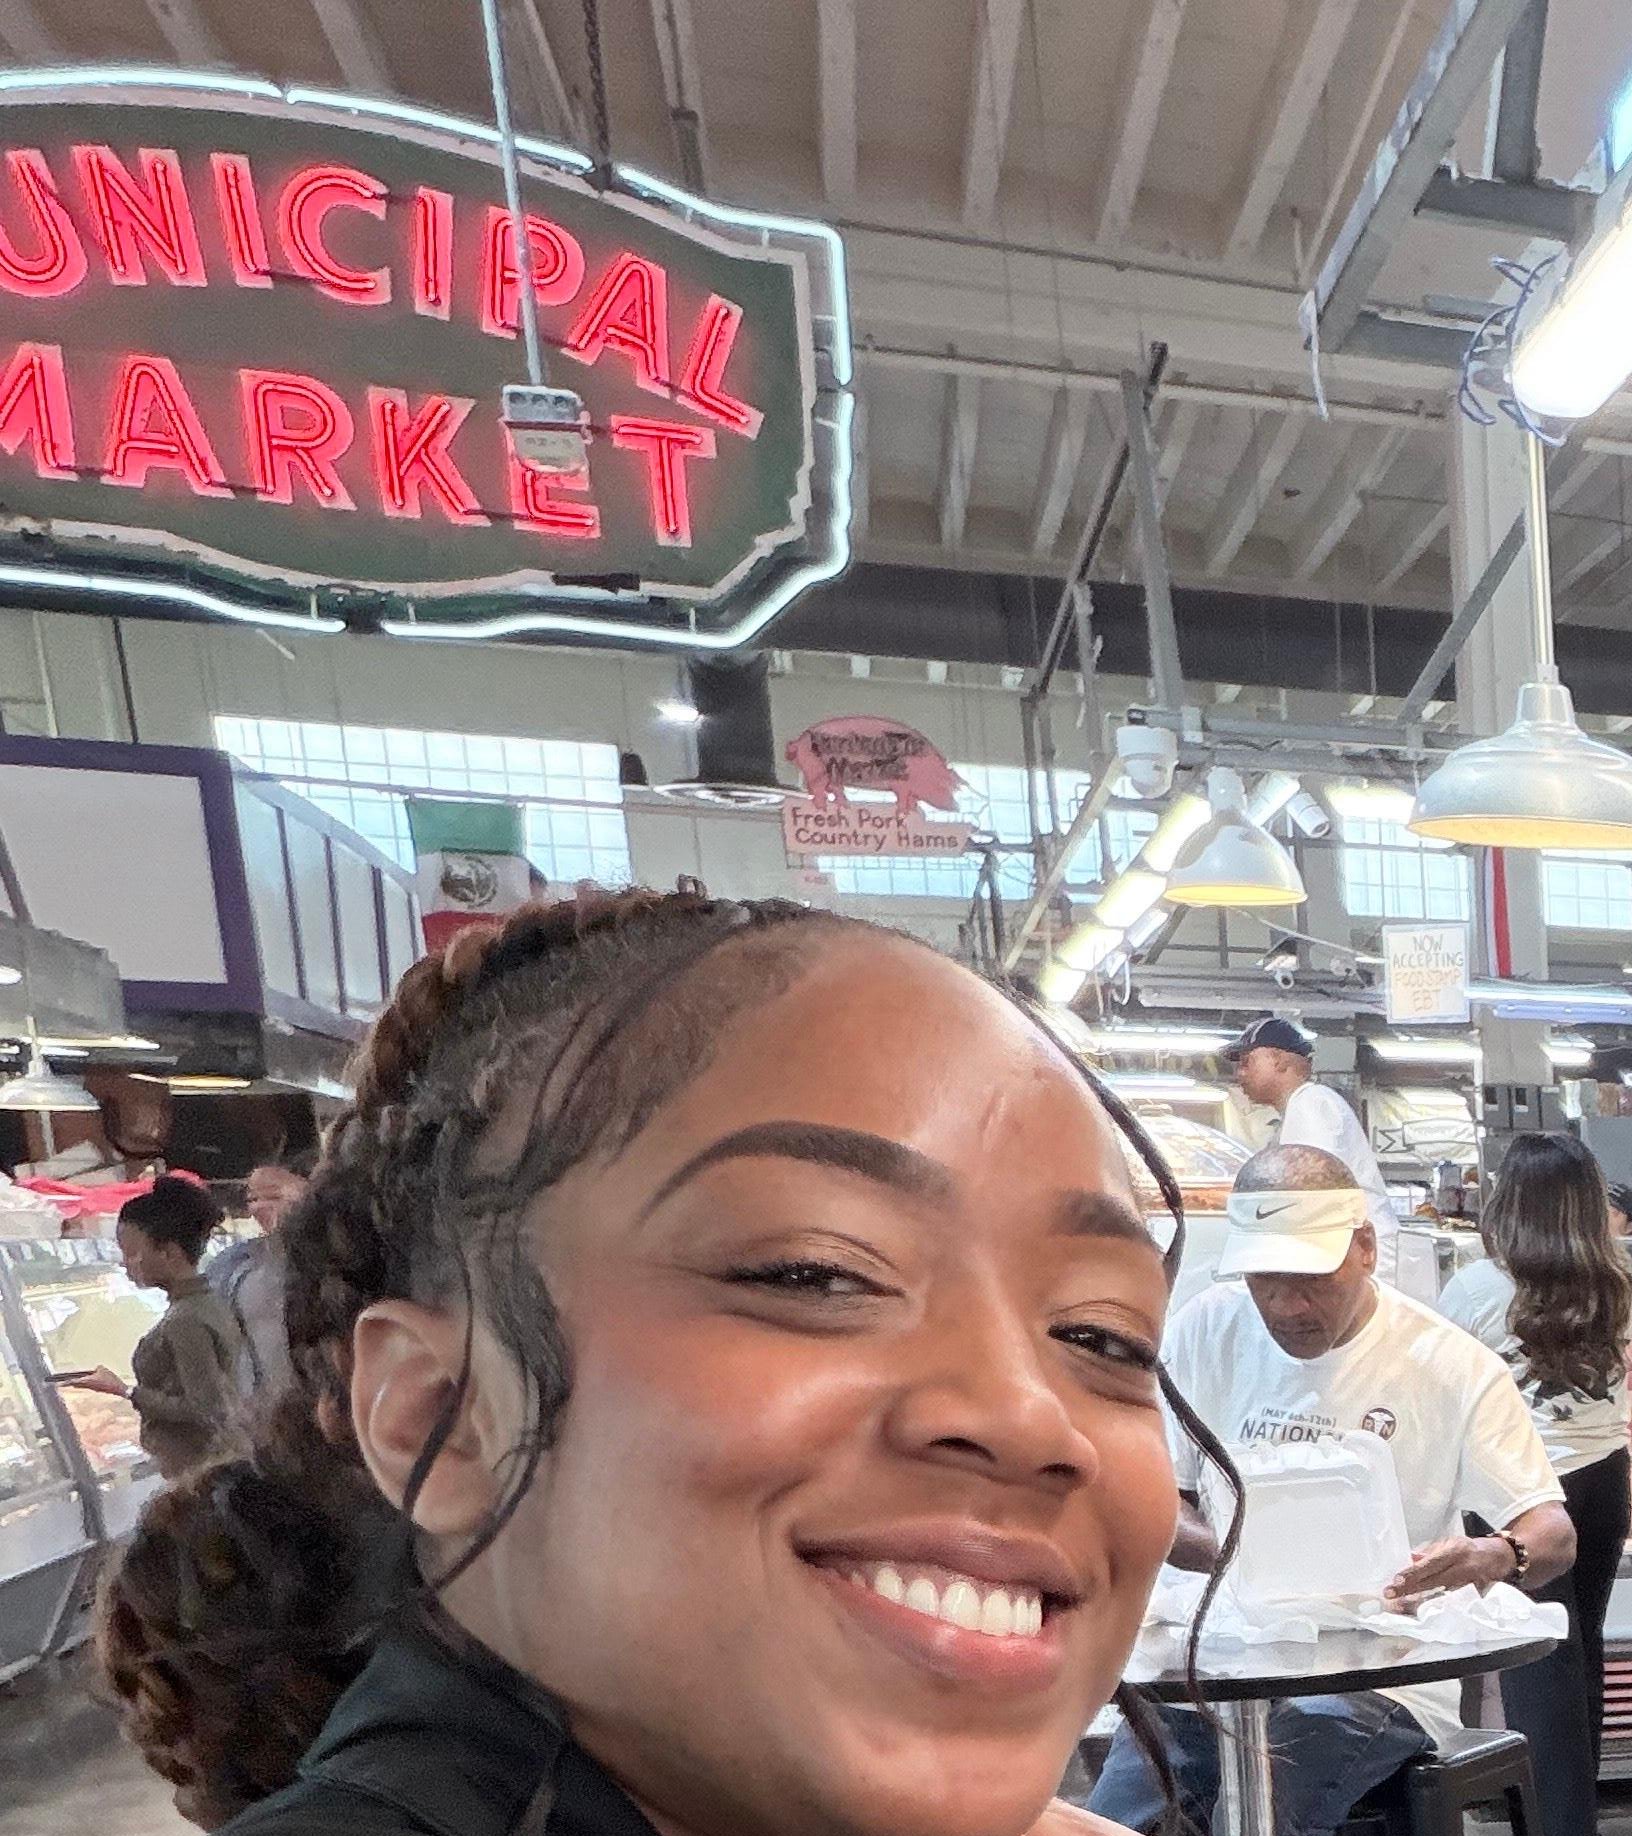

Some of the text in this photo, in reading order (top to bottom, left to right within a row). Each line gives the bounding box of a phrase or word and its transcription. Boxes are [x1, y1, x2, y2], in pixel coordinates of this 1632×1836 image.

[791, 806, 906, 829] Fresh Pork
[795, 827, 959, 852] Country Hams
[1412, 933, 1444, 953] NOW
[1392, 951, 1464, 969] ACCEPTING
